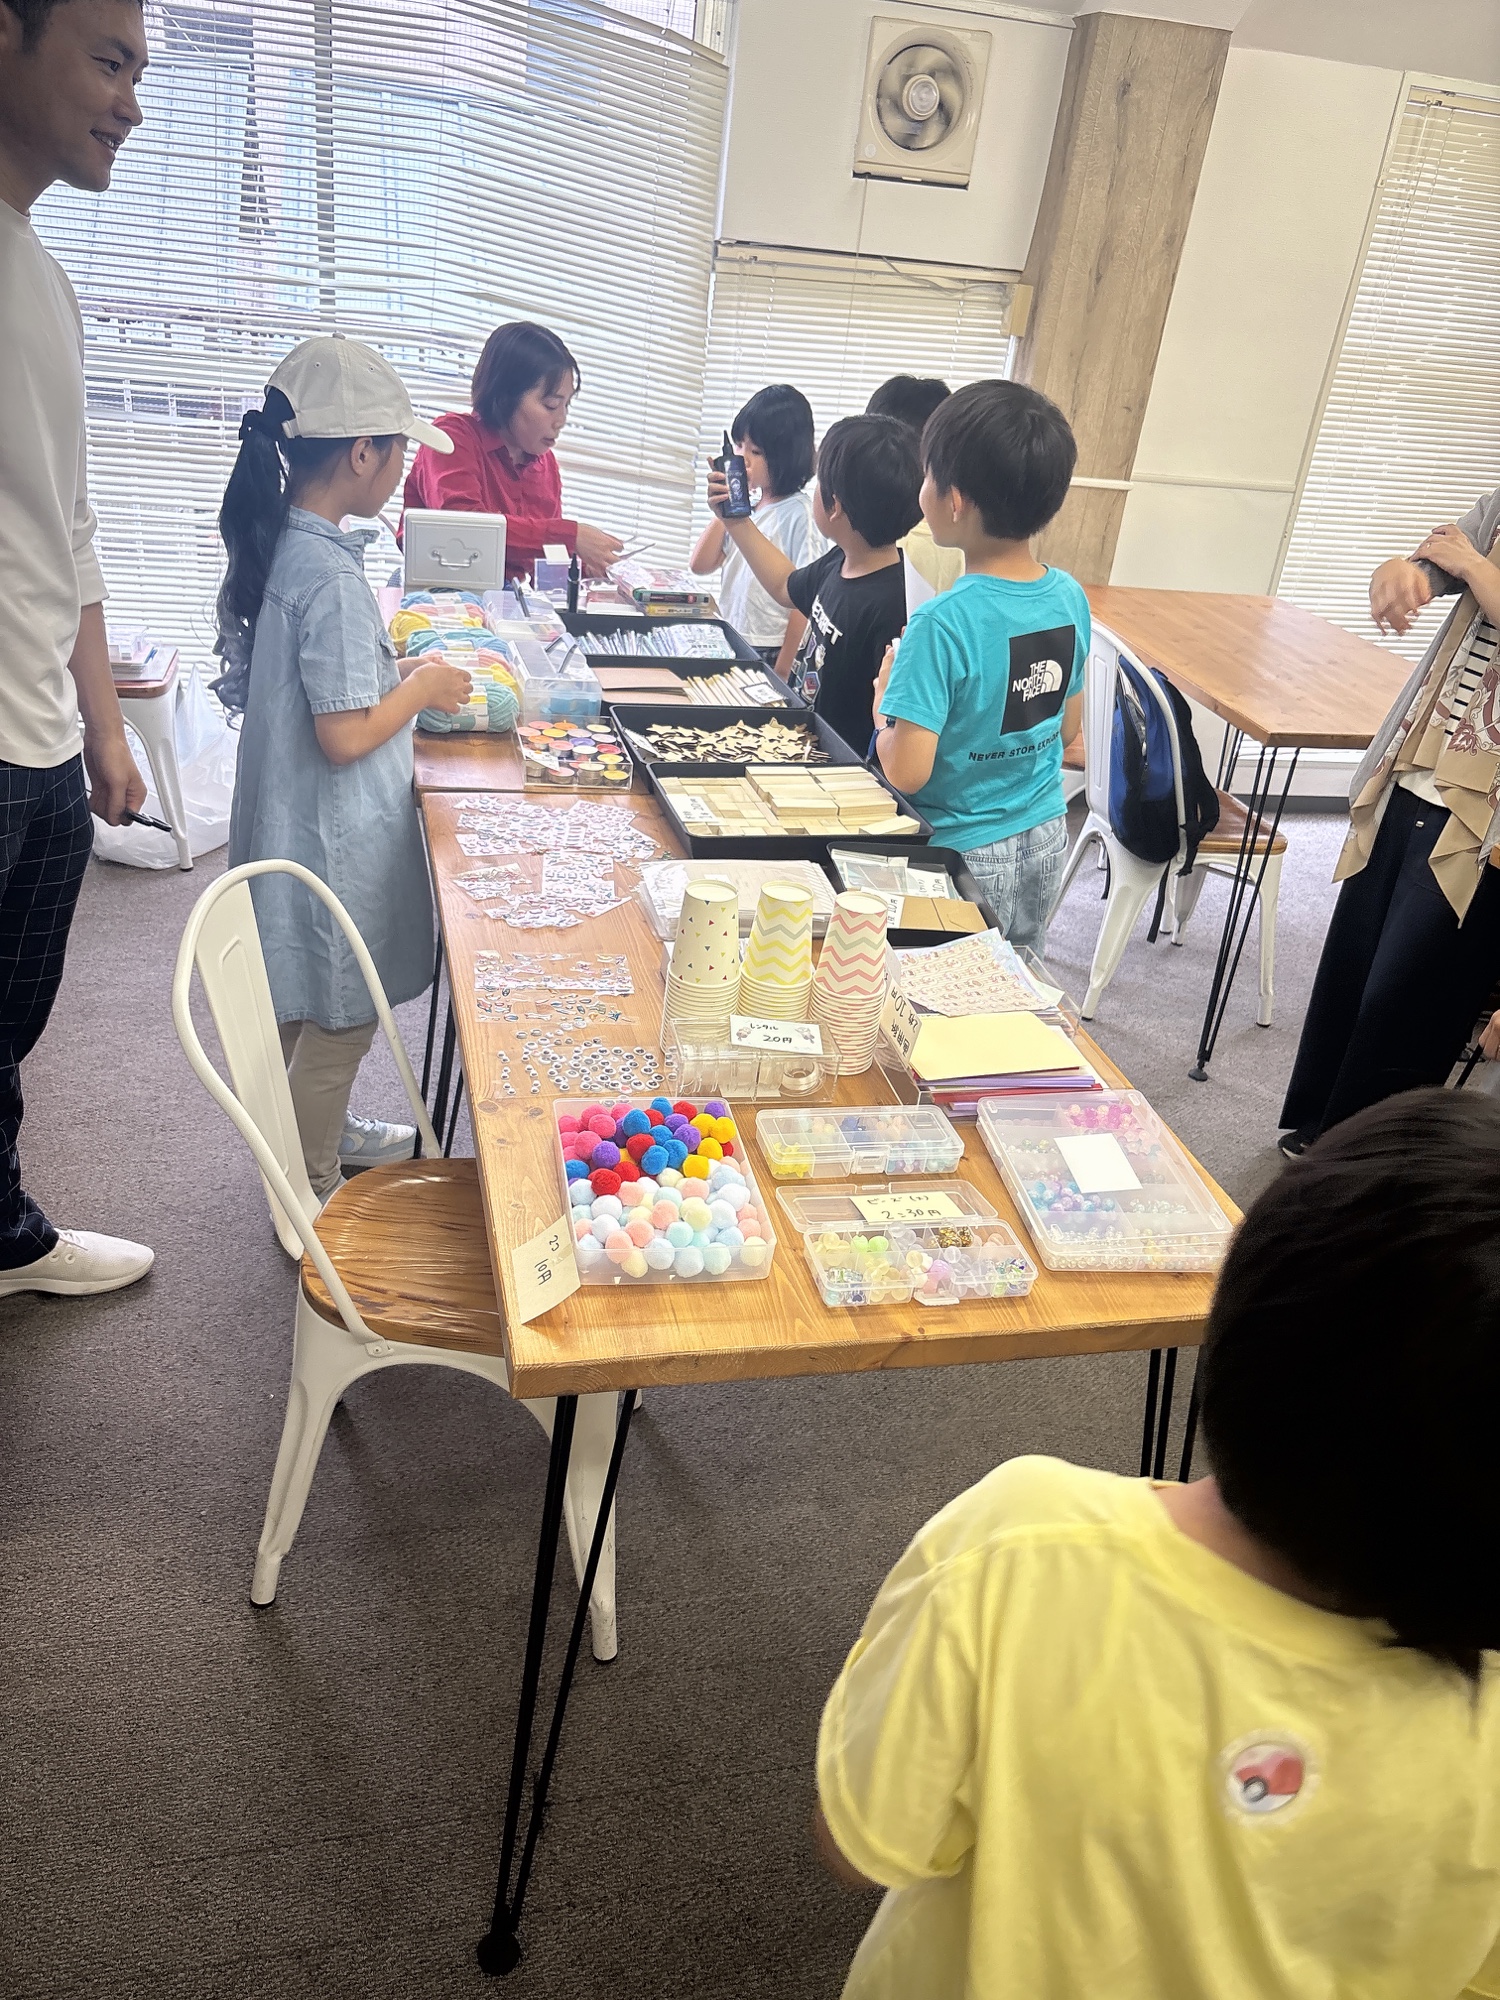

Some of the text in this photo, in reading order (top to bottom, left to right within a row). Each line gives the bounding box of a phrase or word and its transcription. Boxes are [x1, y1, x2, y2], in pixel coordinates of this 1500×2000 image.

[1029, 660, 1047, 676] THE
[1012, 672, 1045, 693] NORTH
[1022, 684, 1042, 702] FACE
[968, 731, 1060, 762] NEVER STOP EXPLOR
[763, 1034, 793, 1044] 20円
[534, 1258, 552, 1286] 10円
